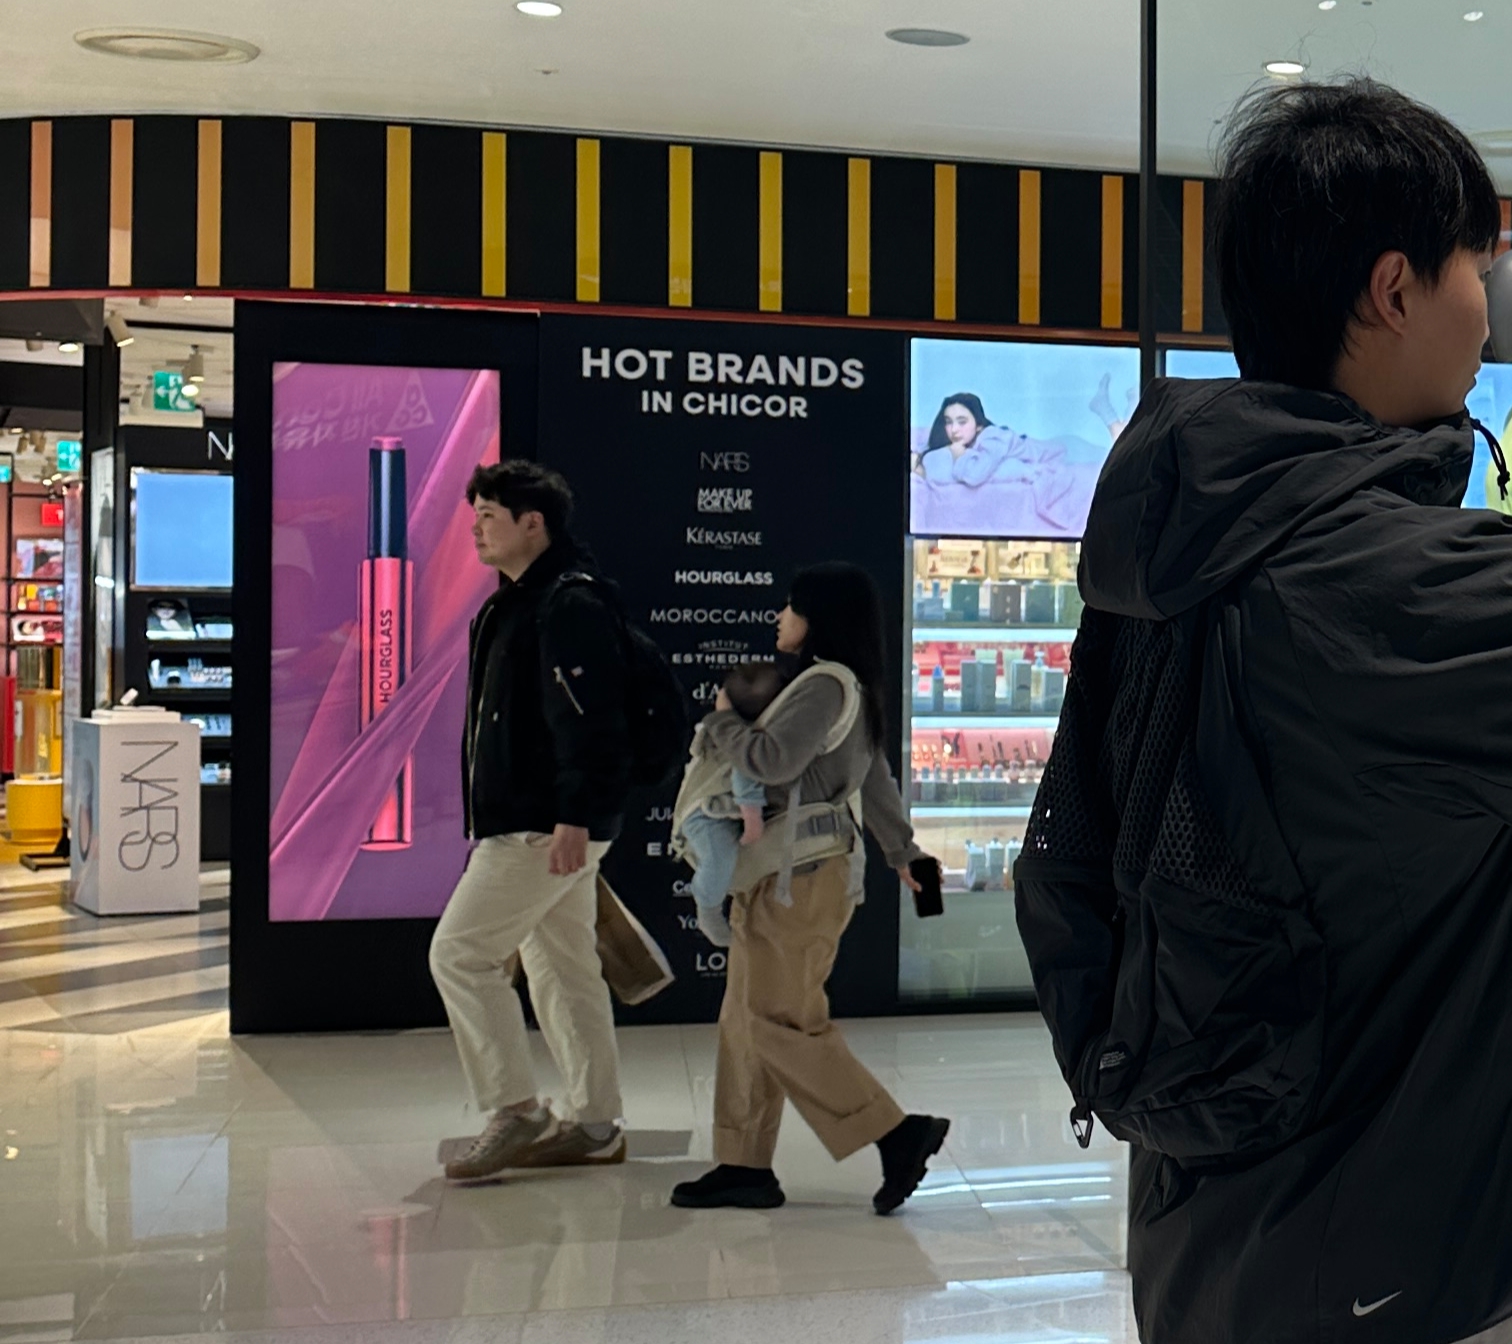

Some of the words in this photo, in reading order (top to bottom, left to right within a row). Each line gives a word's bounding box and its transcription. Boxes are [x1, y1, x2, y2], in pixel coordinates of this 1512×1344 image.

[581, 346, 673, 381] HOT
[687, 351, 865, 389] BRANDS
[641, 390, 672, 413] IN
[682, 391, 808, 418] CHICOR
[700, 451, 750, 473] NARS
[698, 497, 722, 511] FOR
[723, 497, 753, 511] EVER
[699, 488, 734, 499] MAKE
[736, 488, 753, 499] UP
[674, 570, 774, 586] HOURGLASS
[380, 609, 393, 703] HOURGLASS
[671, 653, 776, 665] ESTHEDERM
[118, 740, 180, 872] NARS
